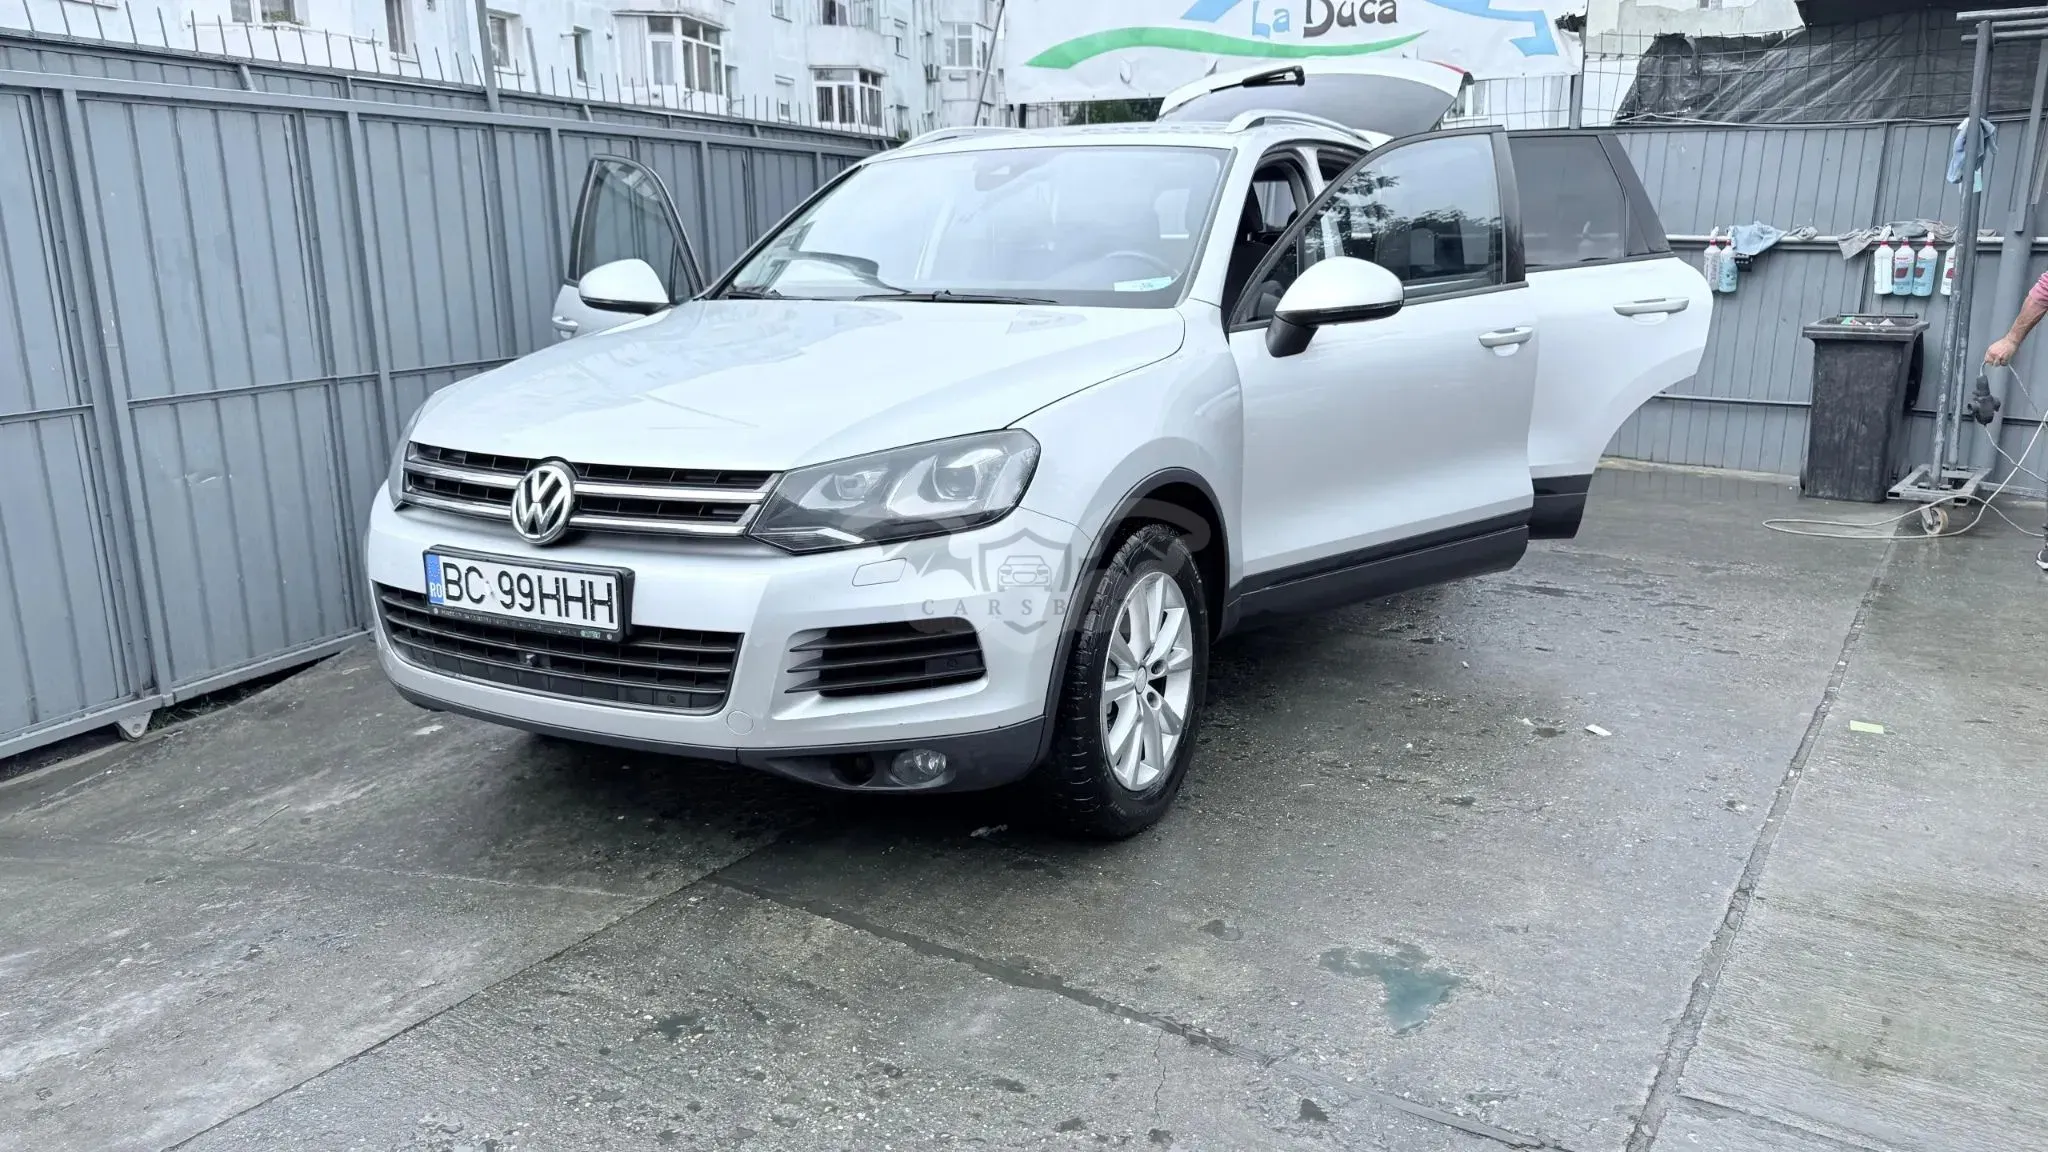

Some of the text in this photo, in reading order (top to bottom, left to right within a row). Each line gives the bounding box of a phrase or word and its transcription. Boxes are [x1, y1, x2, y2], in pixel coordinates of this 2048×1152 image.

[1252, 0, 1399, 39] La Duca
[429, 581, 443, 599] RO
[442, 562, 486, 604] BC
